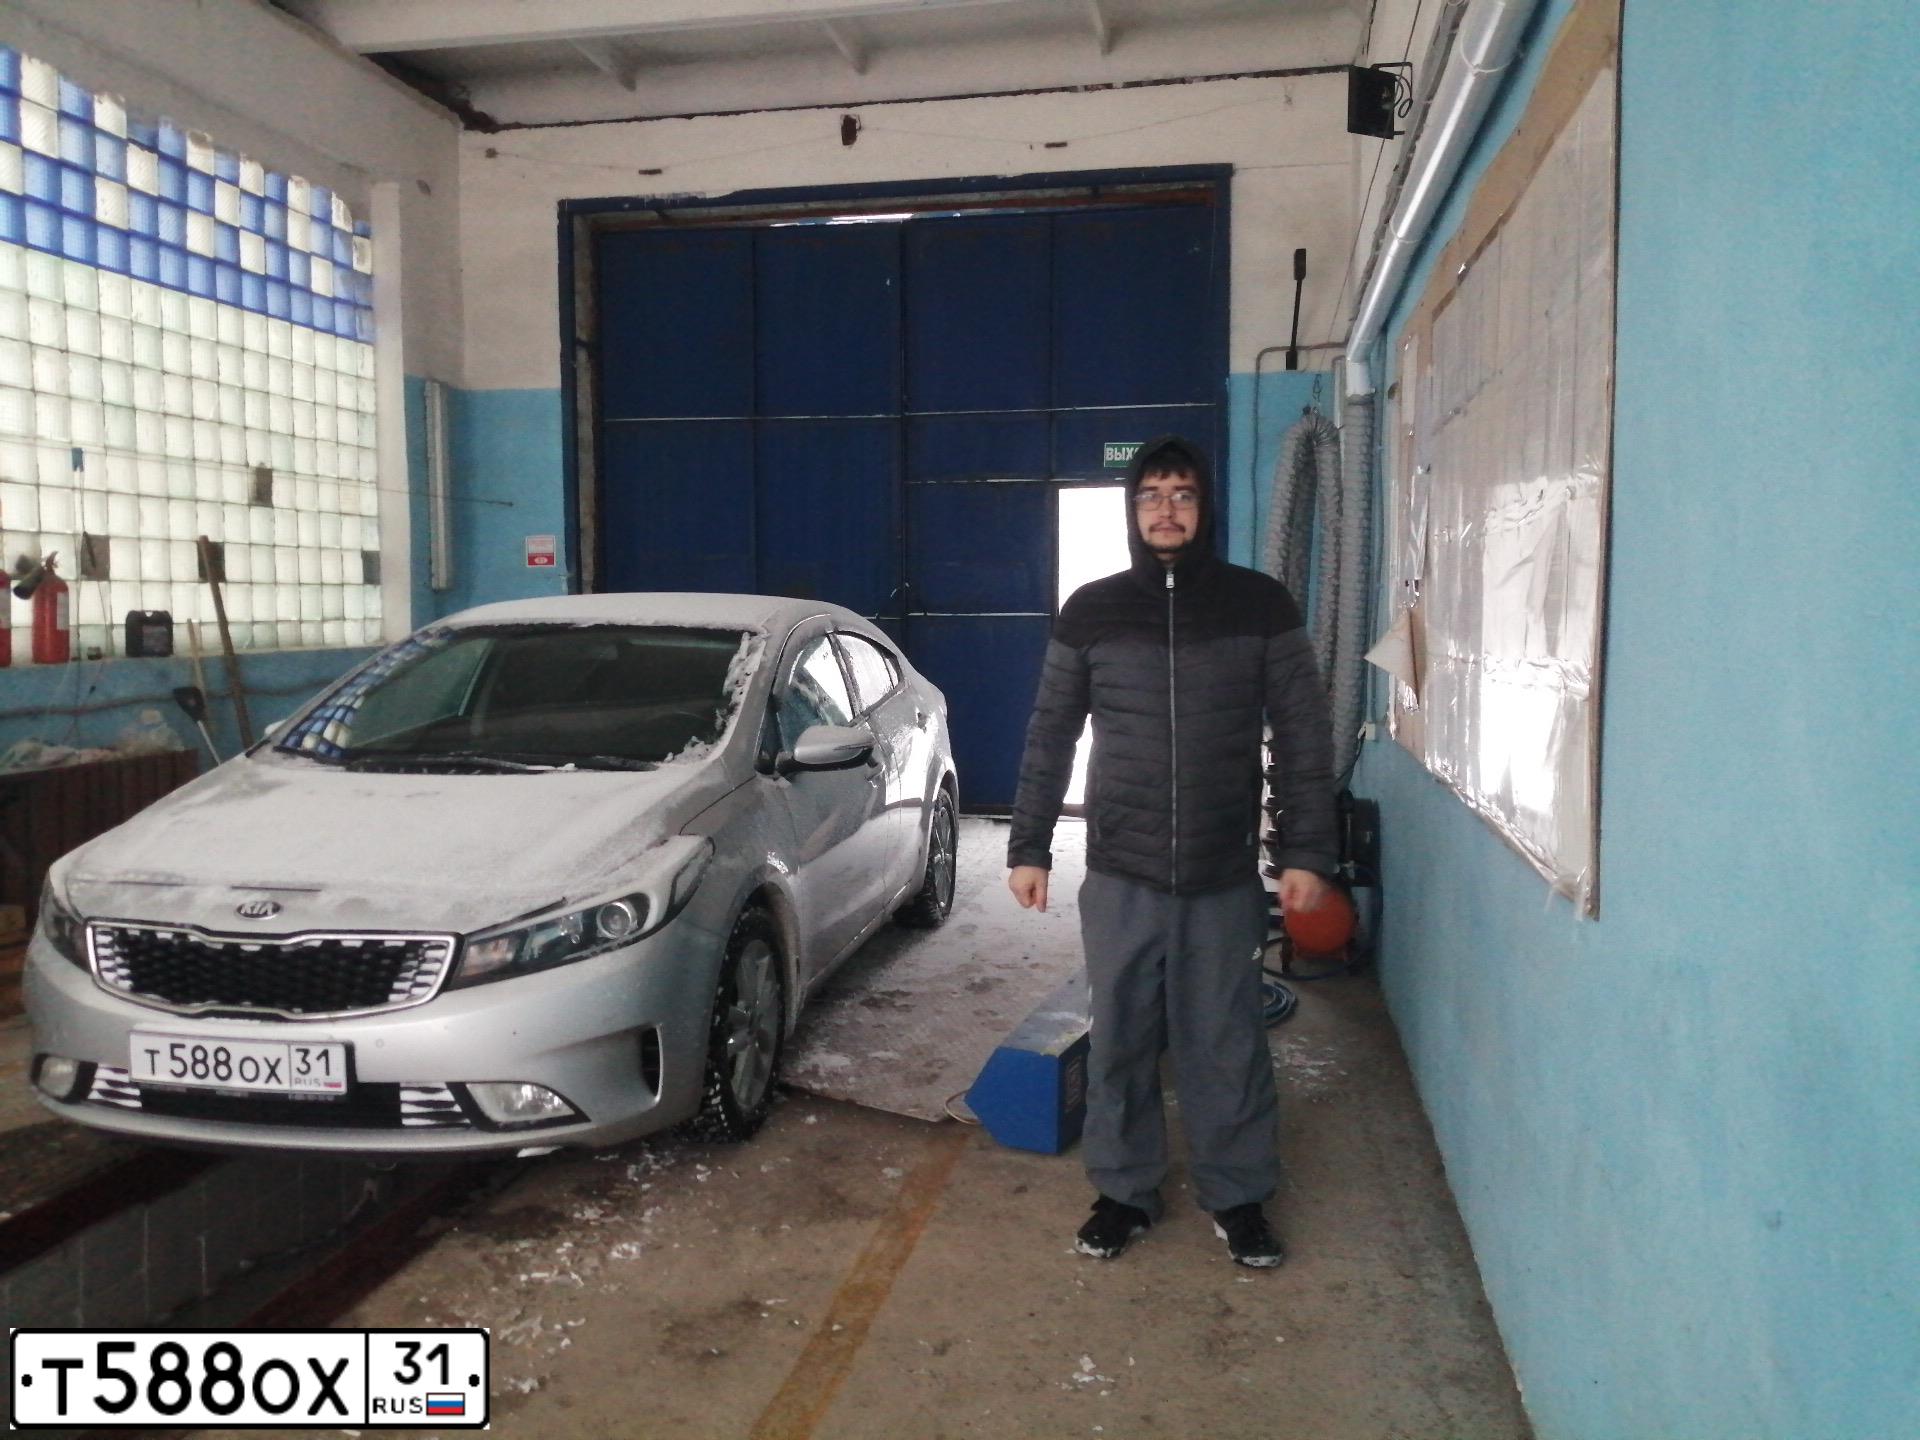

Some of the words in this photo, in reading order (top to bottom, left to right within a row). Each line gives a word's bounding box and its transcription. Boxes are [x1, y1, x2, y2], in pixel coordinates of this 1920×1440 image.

[144, 1043, 283, 1085] Т588ОХ
[295, 1048, 331, 1077] 31
[294, 1078, 321, 1088] RUS
